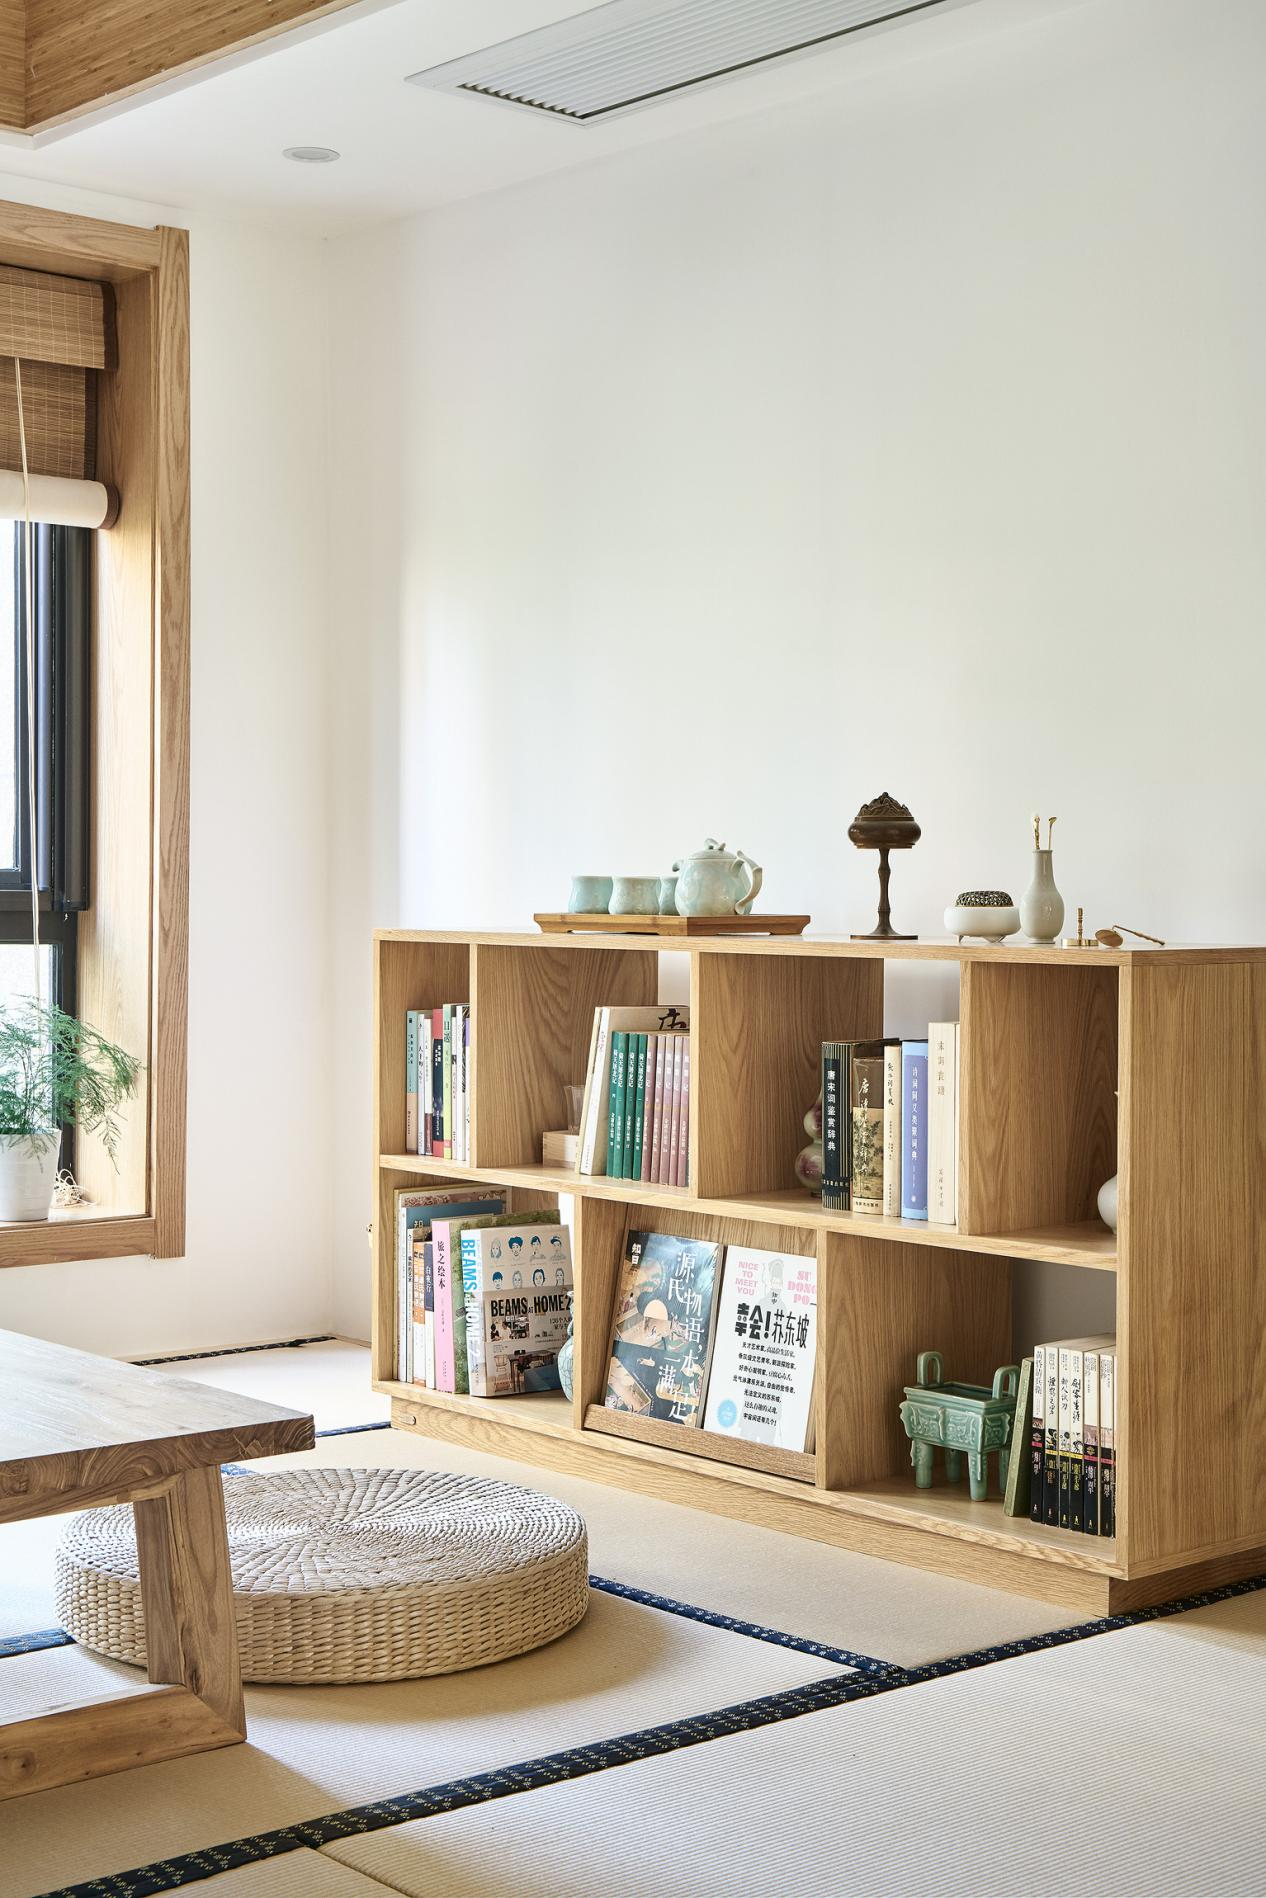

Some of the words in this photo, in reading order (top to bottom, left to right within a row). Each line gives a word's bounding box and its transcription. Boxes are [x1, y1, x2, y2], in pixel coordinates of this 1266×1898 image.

[827, 1070, 836, 1151] 唐宋词鉴赏辞典
[632, 1243, 642, 1265] 知日
[438, 1240, 446, 1290] 旅之绘本
[461, 1239, 478, 1291] BEAMS
[738, 1261, 759, 1271] NICE
[742, 1270, 753, 1278] TO
[796, 1270, 812, 1281] SU
[736, 1278, 758, 1288] MEET
[737, 1287, 755, 1296] YOU
[793, 1294, 810, 1305] PO
[490, 1297, 528, 1317] BEAMS
[528, 1306, 534, 1314] AT
